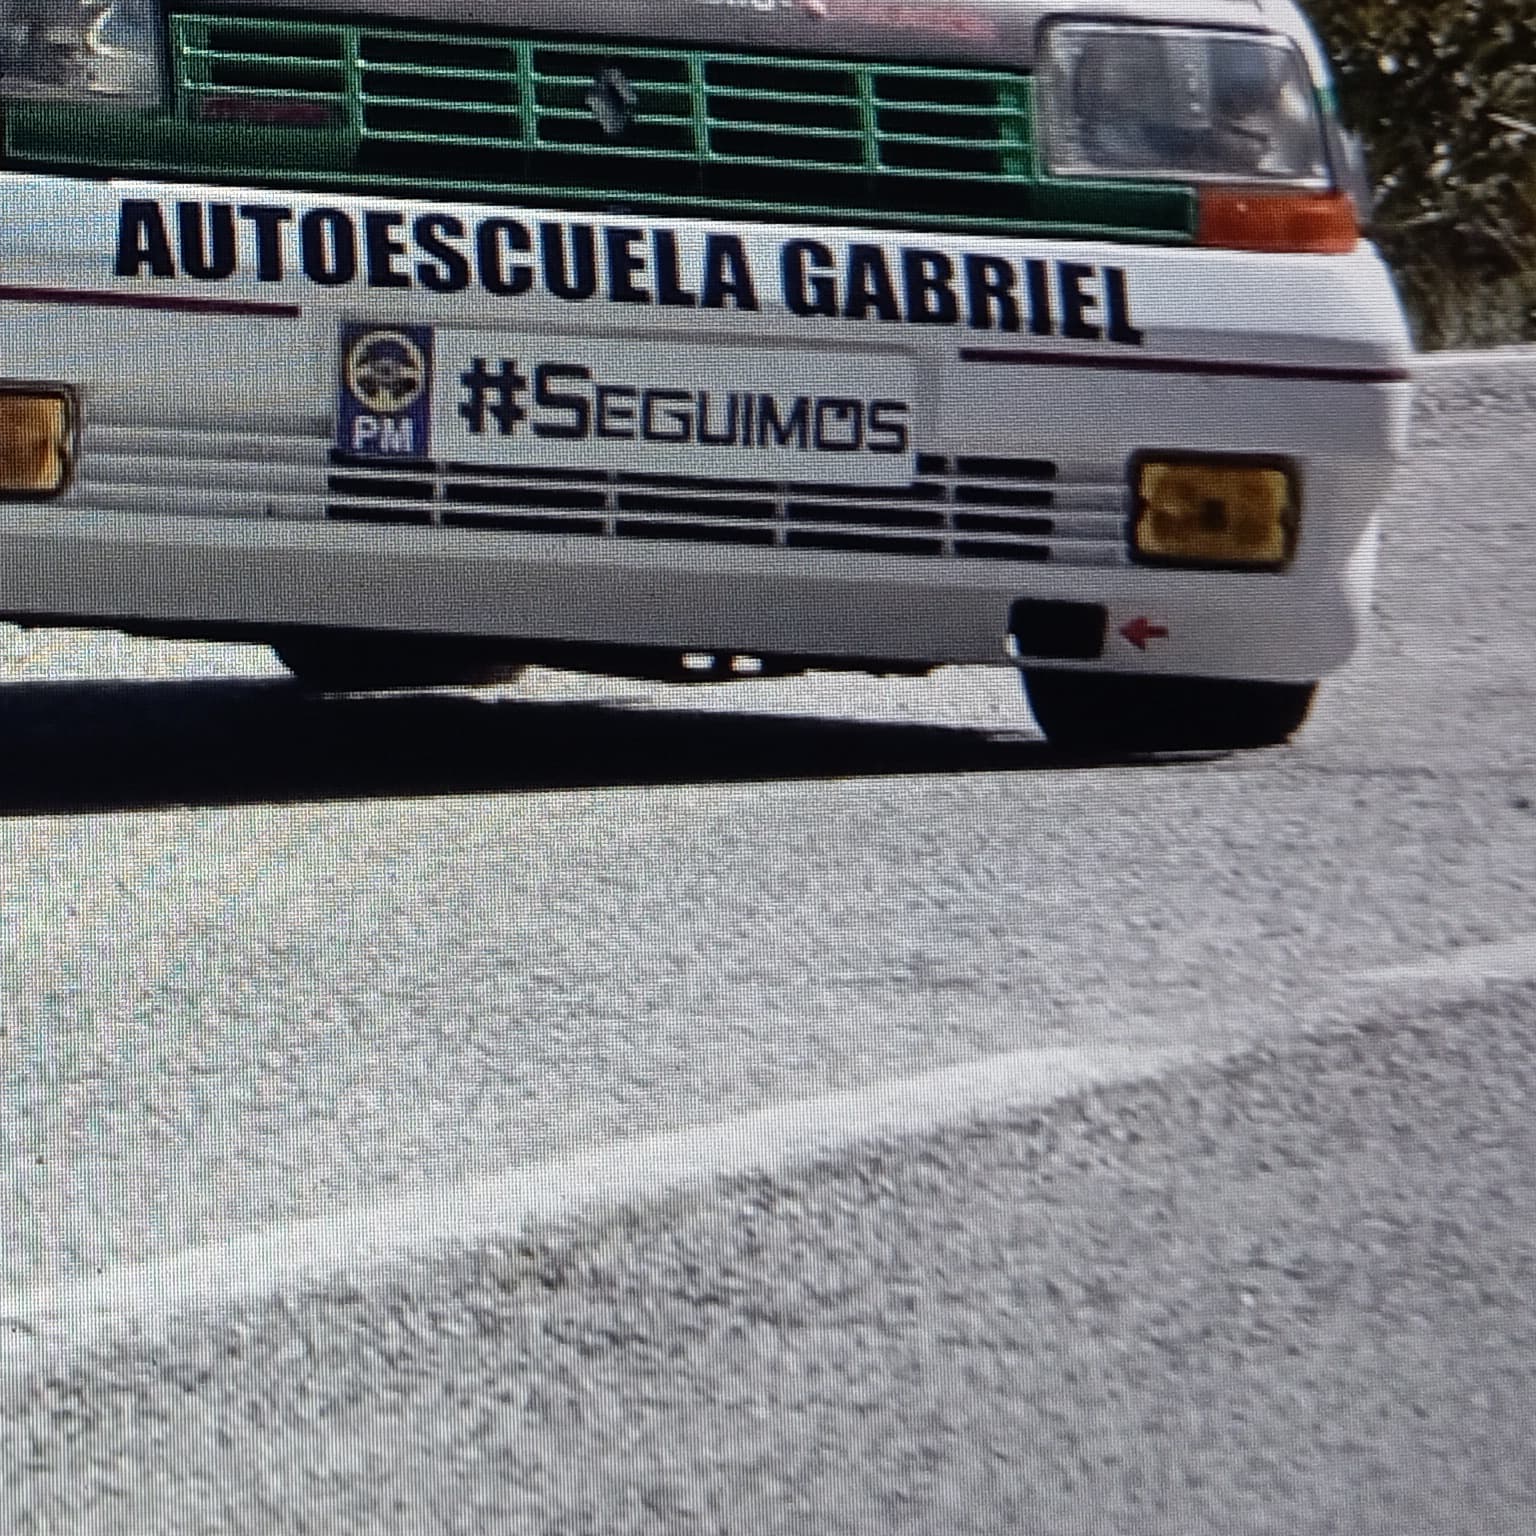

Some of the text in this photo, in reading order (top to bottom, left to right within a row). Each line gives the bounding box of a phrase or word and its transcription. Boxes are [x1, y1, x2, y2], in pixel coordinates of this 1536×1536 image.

[115, 197, 1144, 346] AUTOESCUELA GABRIEL
[351, 414, 415, 453] PM
